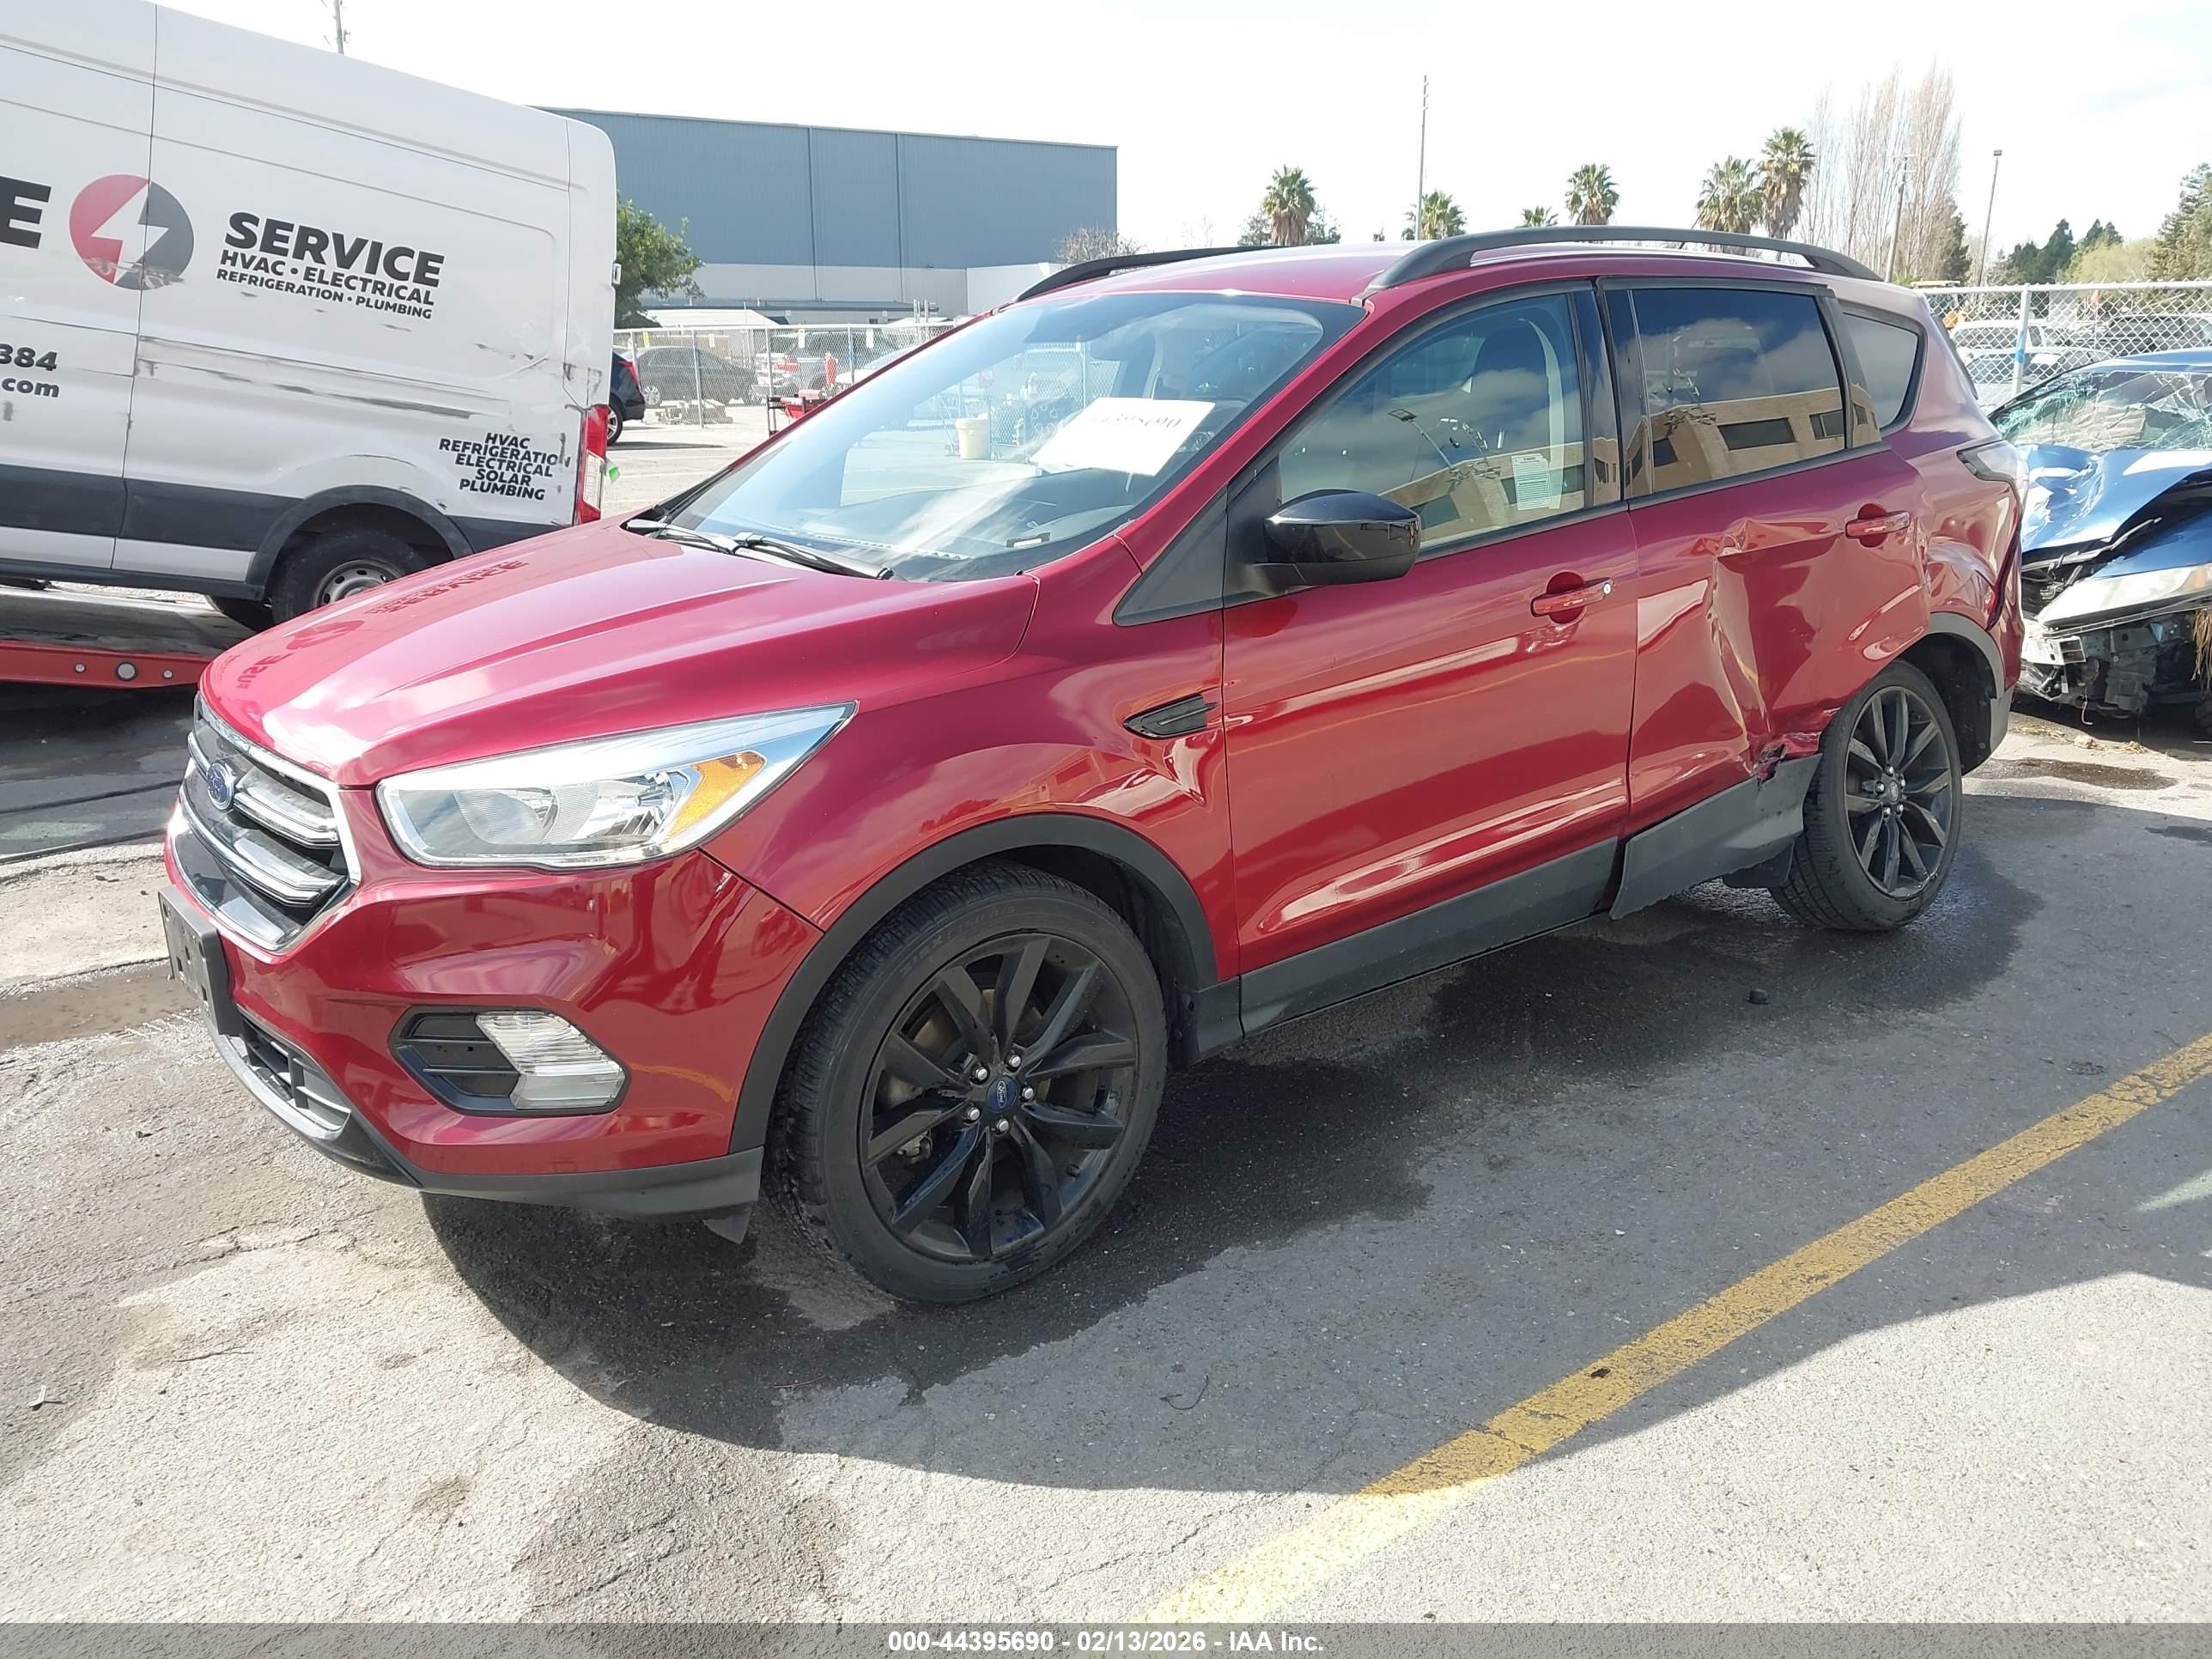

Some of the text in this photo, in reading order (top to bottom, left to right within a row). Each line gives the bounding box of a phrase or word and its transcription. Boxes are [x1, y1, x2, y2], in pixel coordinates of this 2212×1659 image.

[225, 211, 445, 288] SERVICE
[220, 249, 434, 306] HVAC ELECTRICAL
[216, 268, 432, 319] REFRIGERATION PLUMBING
[484, 432, 531, 449] HVAC
[455, 453, 553, 477] ELECTRICAL
[459, 478, 545, 501] PLUMBING
[475, 468, 532, 487] SOLAR
